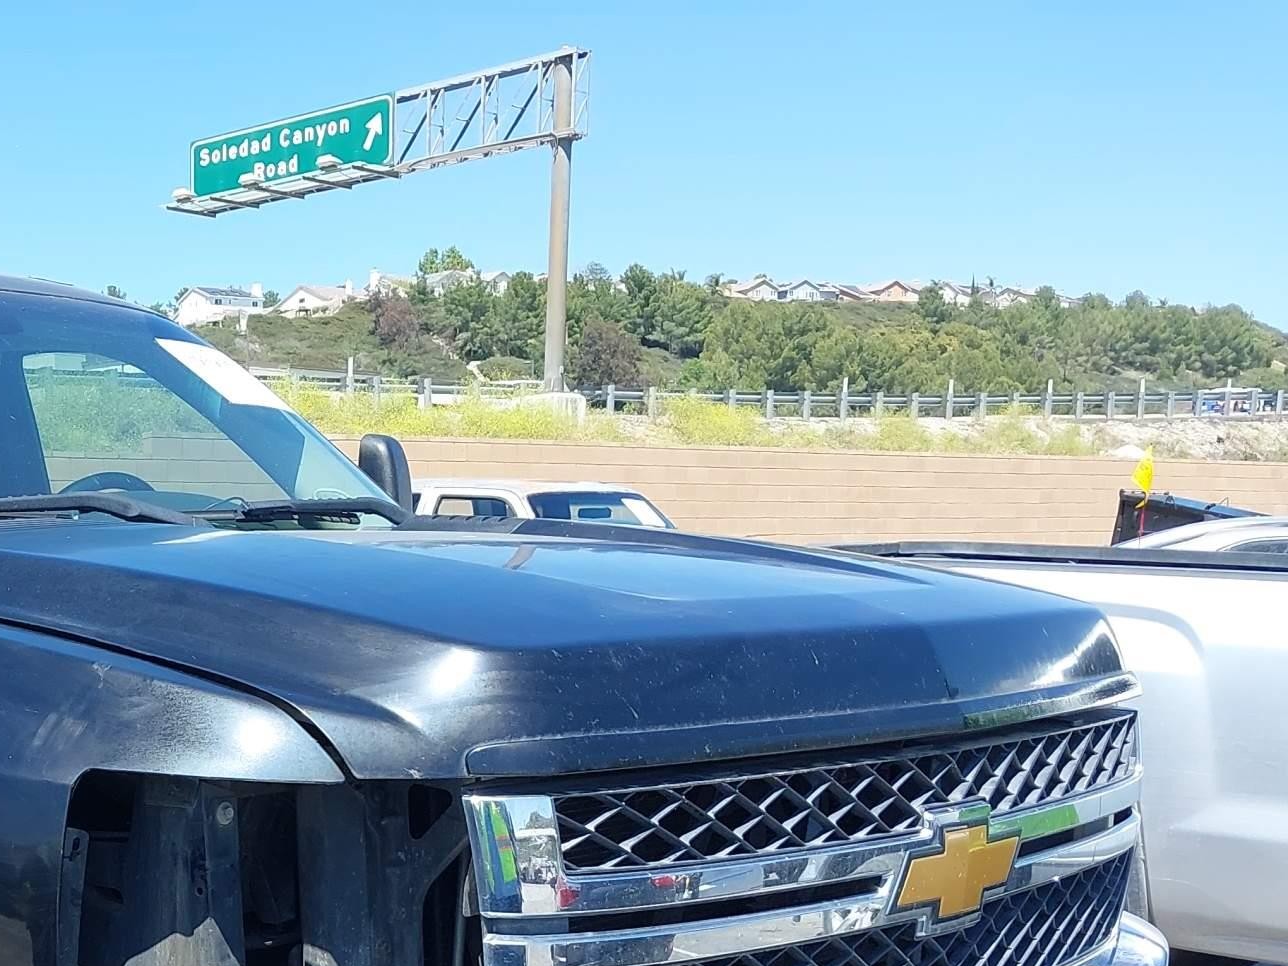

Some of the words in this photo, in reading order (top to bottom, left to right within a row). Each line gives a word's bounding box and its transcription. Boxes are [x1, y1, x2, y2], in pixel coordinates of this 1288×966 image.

[199, 133, 272, 167] Soledad
[279, 117, 350, 147] Canyon
[252, 154, 299, 179] Road
